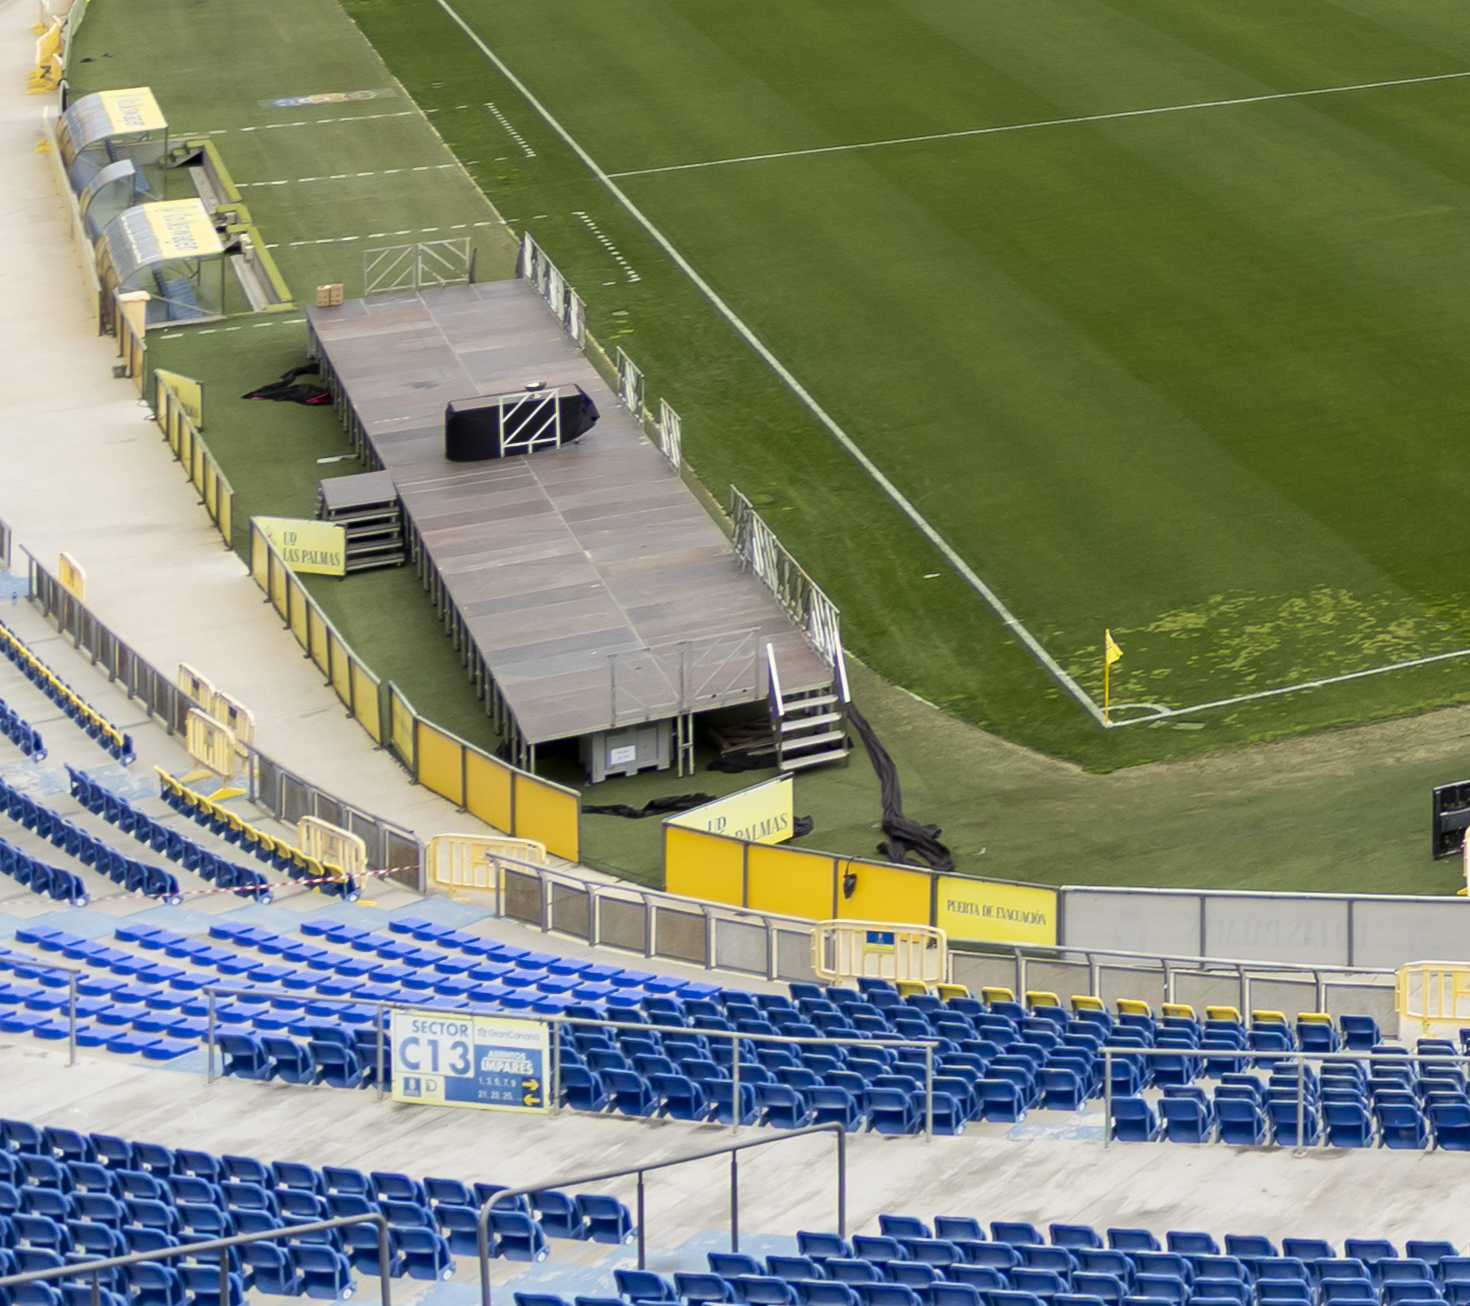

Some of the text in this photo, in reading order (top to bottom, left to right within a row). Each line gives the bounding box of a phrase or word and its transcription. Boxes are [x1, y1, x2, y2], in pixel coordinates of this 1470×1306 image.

[284, 531, 298, 546] UD
[283, 547, 342, 567] LAS PALMAS
[735, 812, 788, 841] PALMAS
[947, 899, 979, 916] PUERTA
[982, 904, 994, 918] DE
[412, 1020, 469, 1038] SECTOR
[399, 1037, 471, 1076] C13
[481, 1058, 535, 1075] IMPARES
